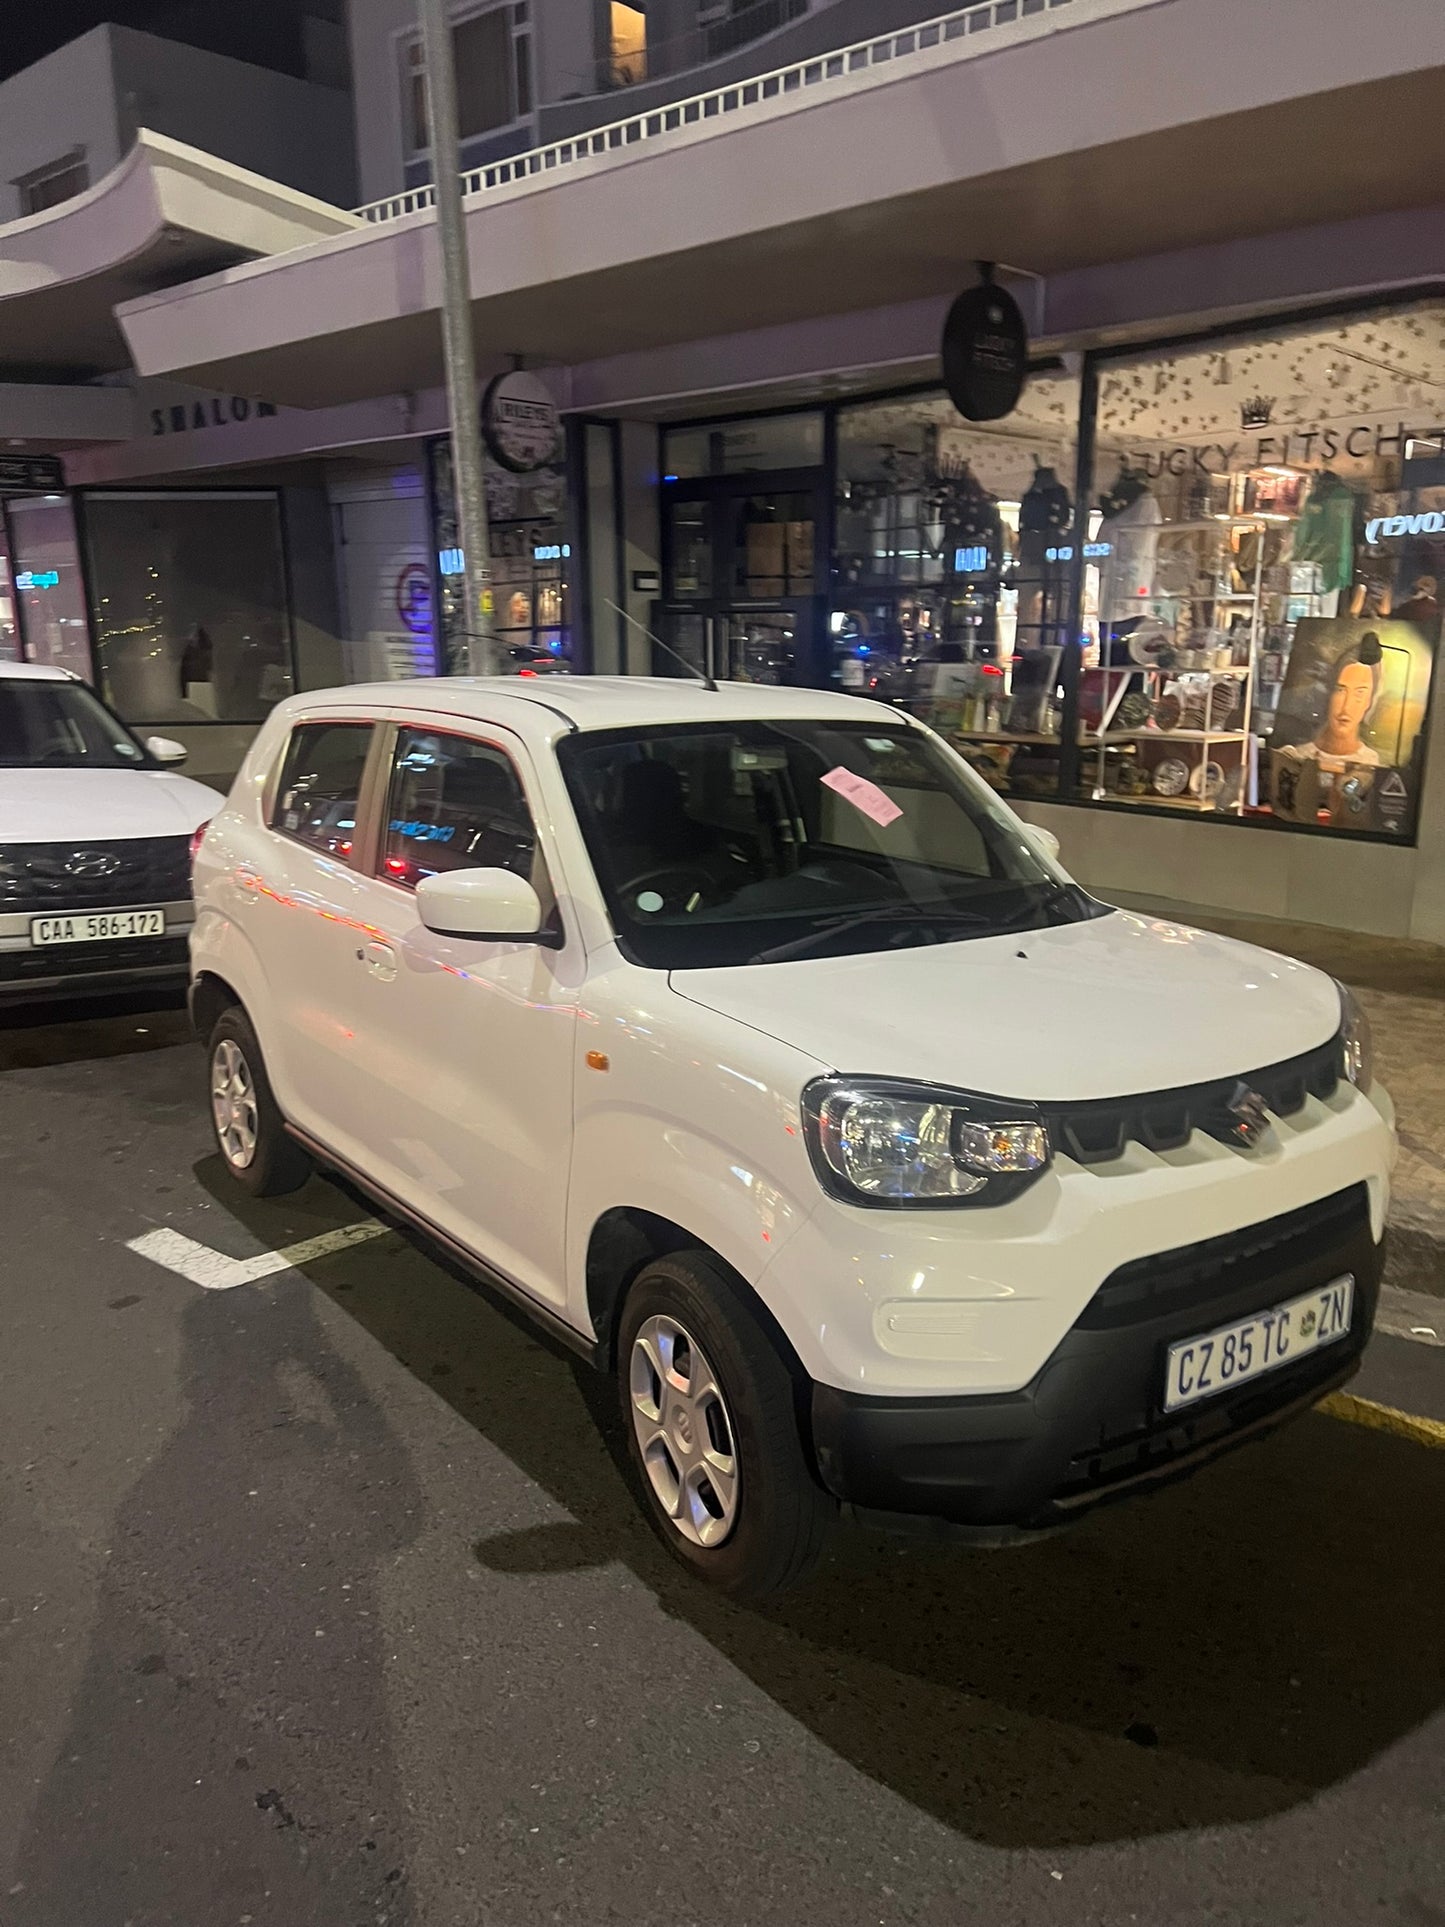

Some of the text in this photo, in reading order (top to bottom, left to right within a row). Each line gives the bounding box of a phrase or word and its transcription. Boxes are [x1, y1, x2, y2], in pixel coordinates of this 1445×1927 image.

[1145, 441, 1239, 478] UCKY
[1257, 421, 1403, 467] FITSCH
[40, 914, 159, 941] CAA 586-172
[1178, 1286, 1346, 1396] CZ 85 TC ZN
